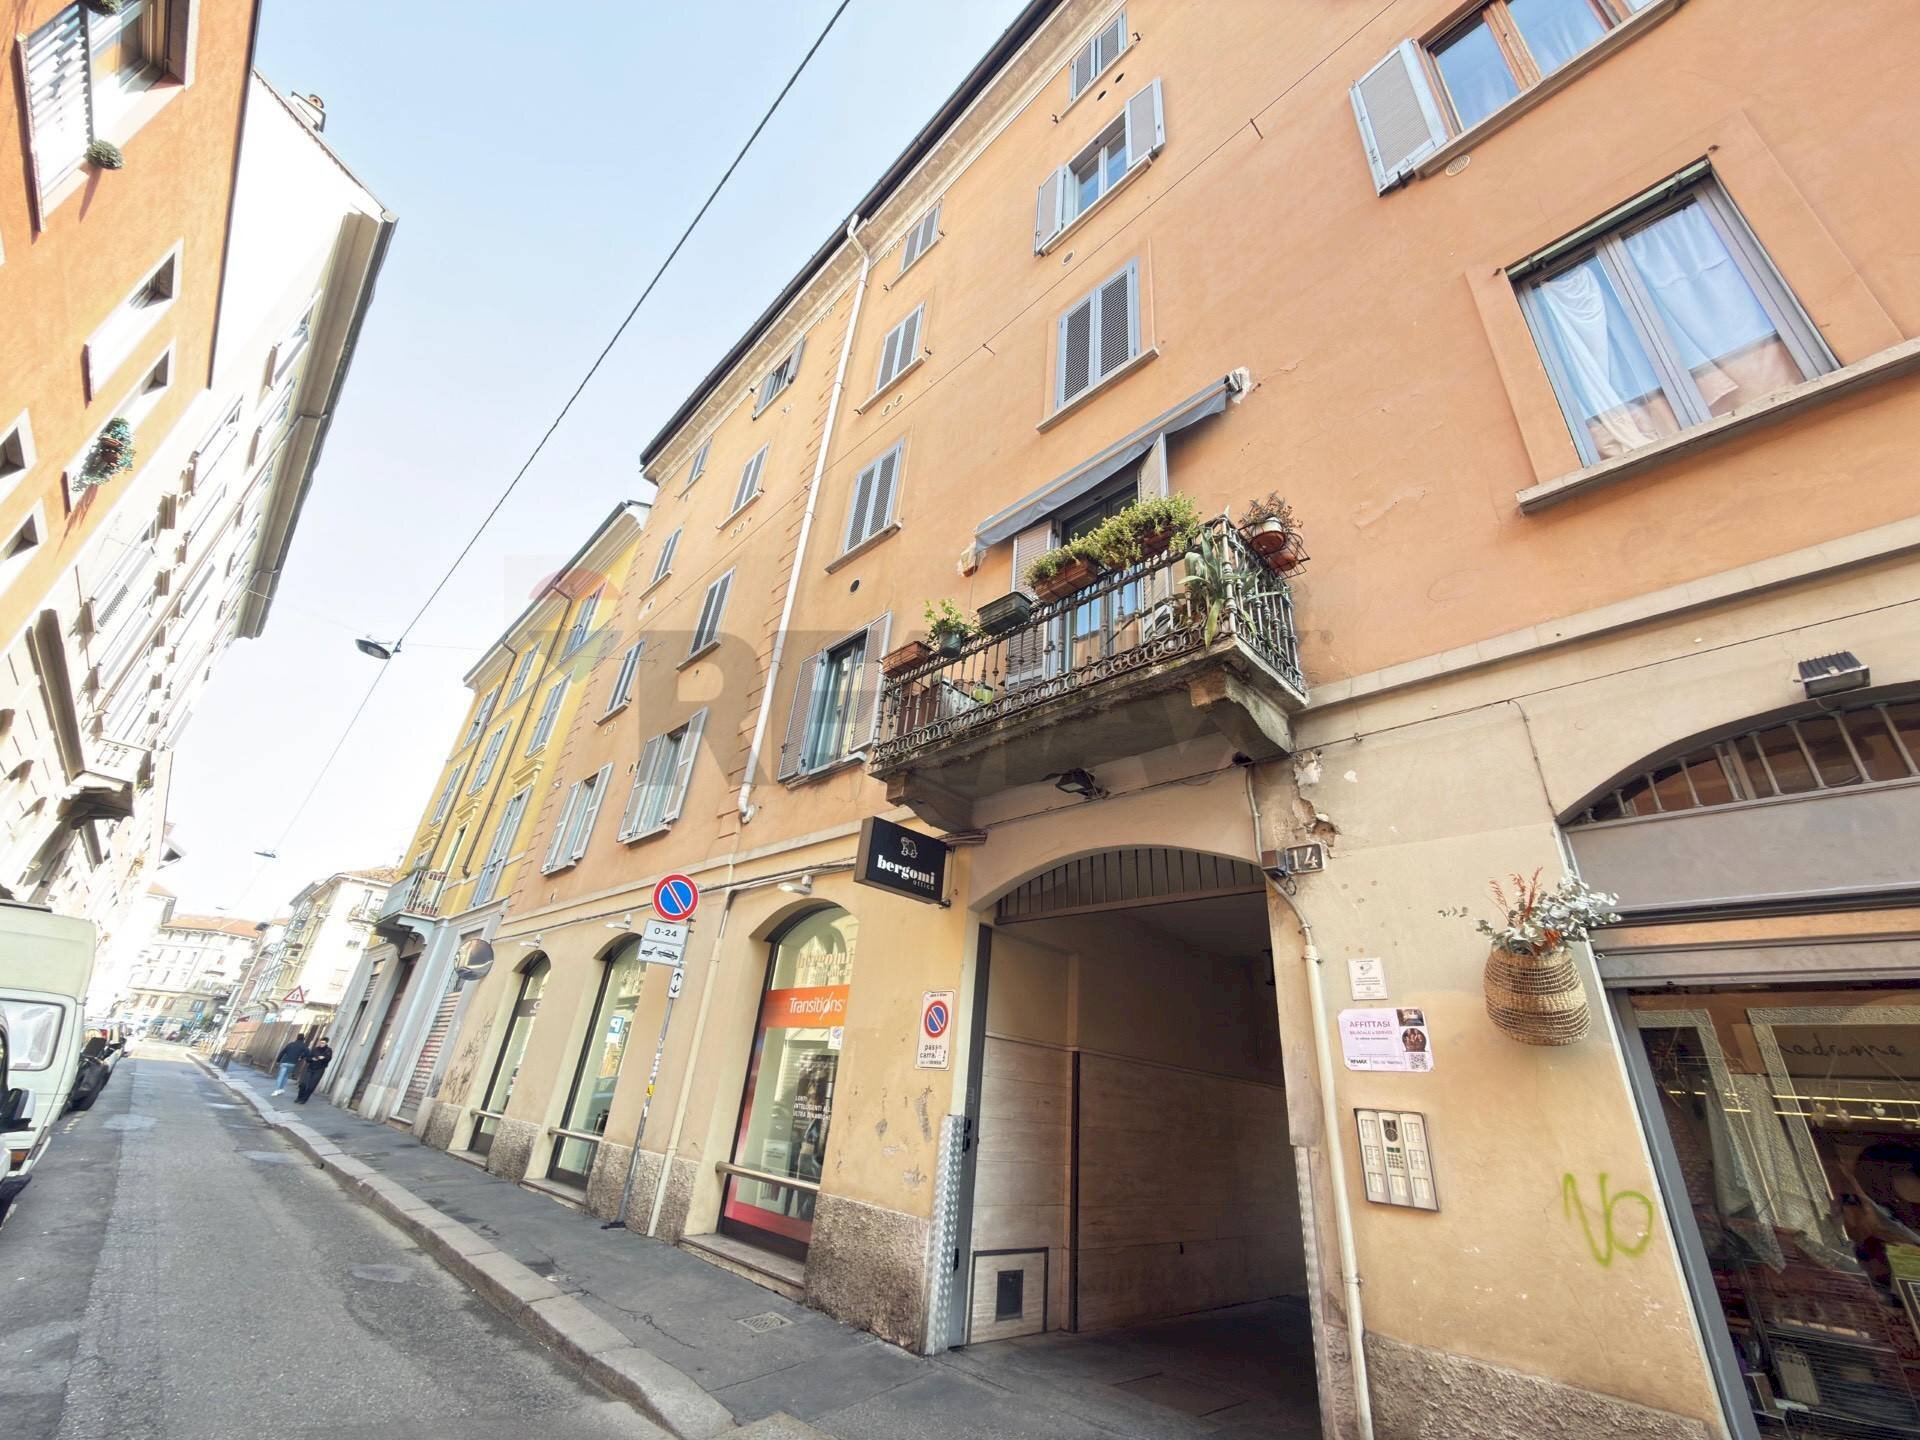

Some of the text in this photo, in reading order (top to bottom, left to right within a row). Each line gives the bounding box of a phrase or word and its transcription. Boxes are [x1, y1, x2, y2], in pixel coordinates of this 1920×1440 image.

[877, 855, 935, 884] bergomi
[1292, 847, 1318, 871] 14
[654, 927, 677, 938] 0-24
[789, 994, 843, 1017] Transitions
